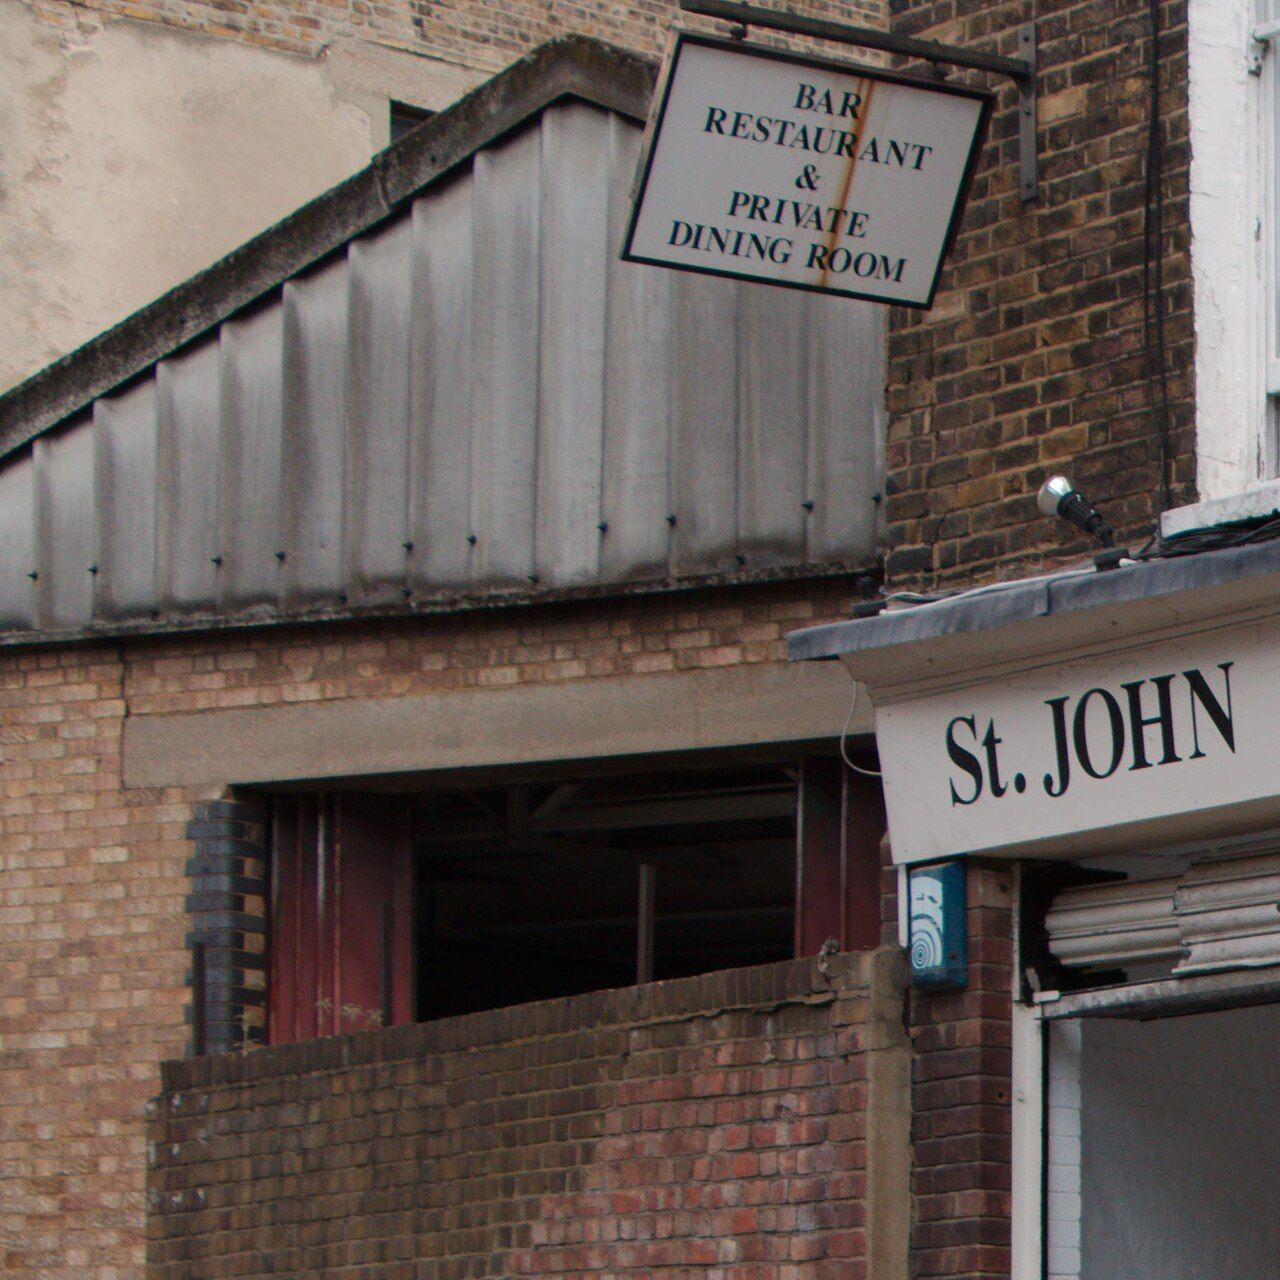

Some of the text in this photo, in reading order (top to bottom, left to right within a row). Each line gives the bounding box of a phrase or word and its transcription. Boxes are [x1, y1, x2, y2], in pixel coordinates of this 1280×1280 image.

[794, 82, 862, 120] BAR
[704, 106, 933, 171] RESTAURANT
[795, 164, 820, 191] &
[727, 191, 869, 238] PRIVATE
[667, 220, 906, 283] DINING ROOM
[945, 661, 1236, 807] St. JOHN
